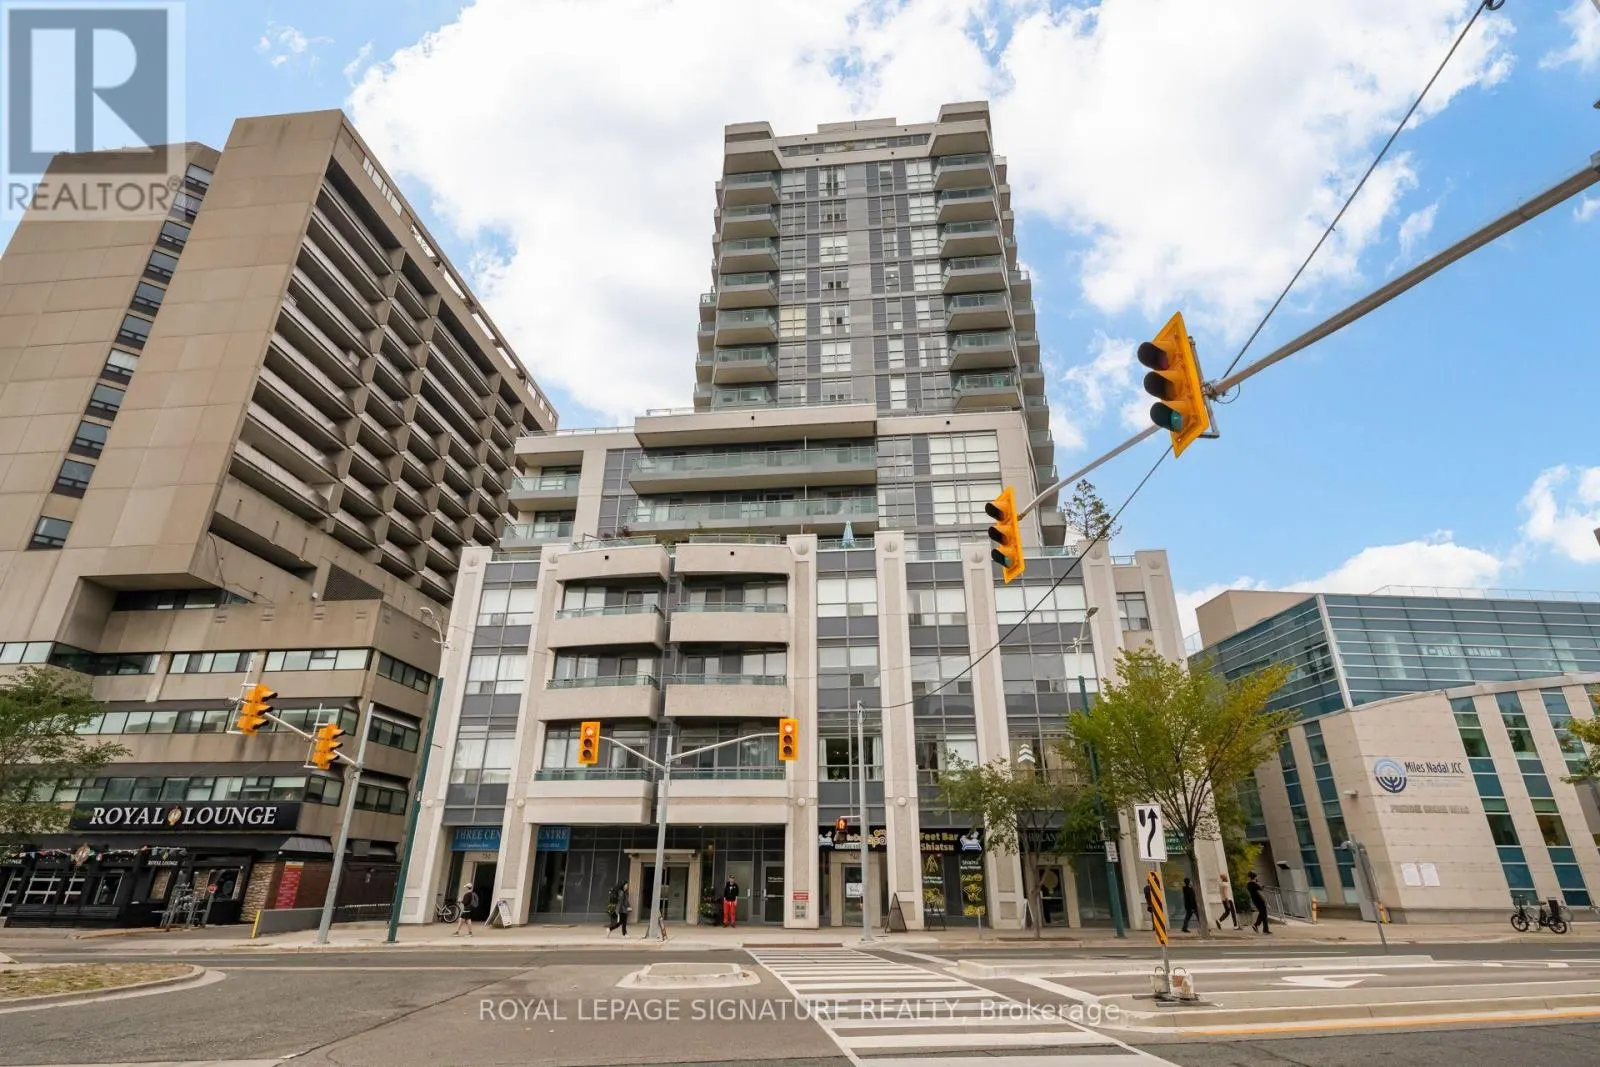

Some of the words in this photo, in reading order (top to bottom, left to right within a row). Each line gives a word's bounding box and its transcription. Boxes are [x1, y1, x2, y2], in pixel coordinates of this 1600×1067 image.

[1404, 761, 1425, 773] Miles
[1426, 762, 1449, 773] Nadal
[1451, 762, 1464, 774] JCC
[89, 806, 164, 825] ROYAL
[182, 806, 277, 825] LOUNGE
[455, 827, 484, 840] THREE
[920, 832, 941, 841] Feet
[942, 832, 958, 841] Bar
[920, 842, 954, 851] Shiatsu
